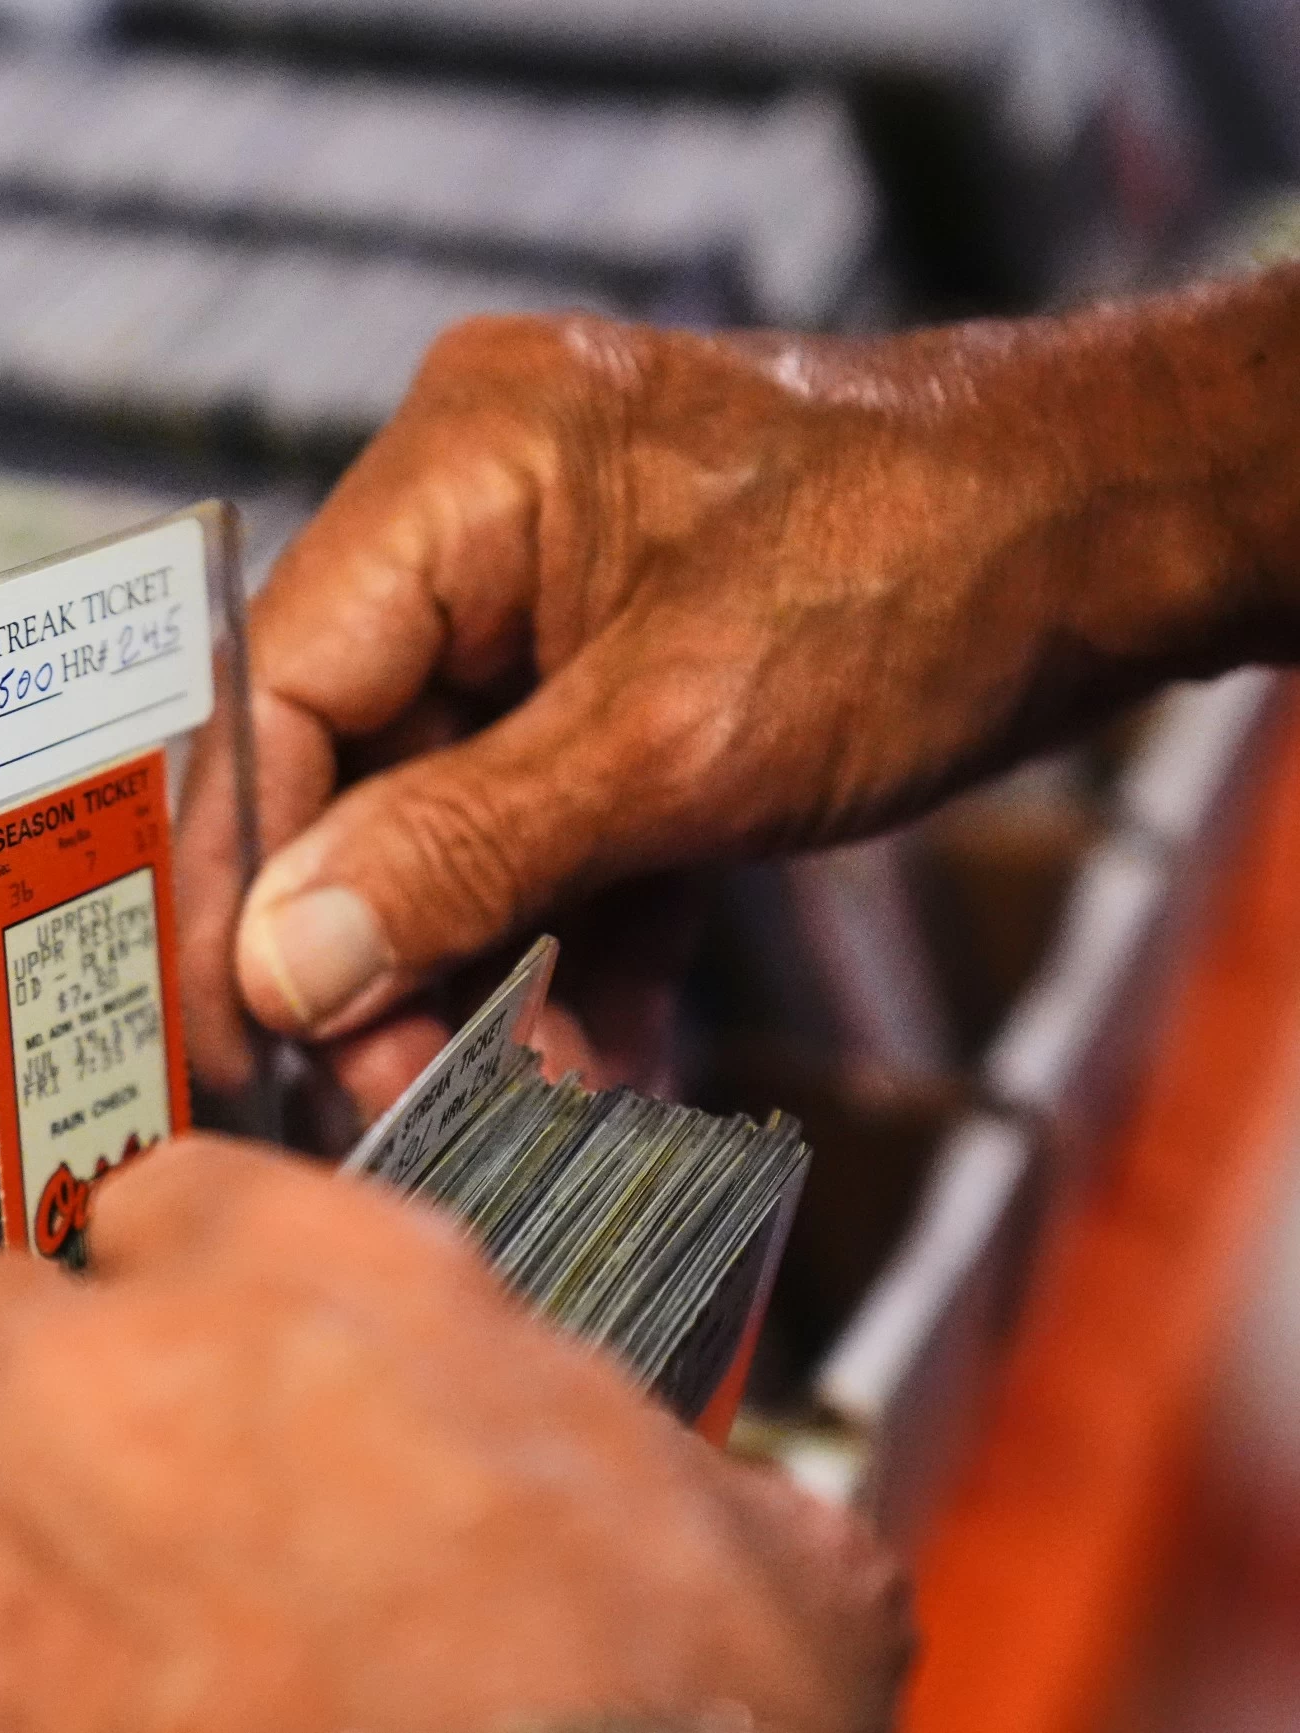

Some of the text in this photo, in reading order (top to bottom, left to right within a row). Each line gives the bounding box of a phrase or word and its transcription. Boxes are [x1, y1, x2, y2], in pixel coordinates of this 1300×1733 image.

[81, 565, 174, 625] TICKET
[82, 767, 150, 815] TICKET
[402, 1008, 509, 1141] STREAK TICKET
[50, 1109, 86, 1138] RAIN
